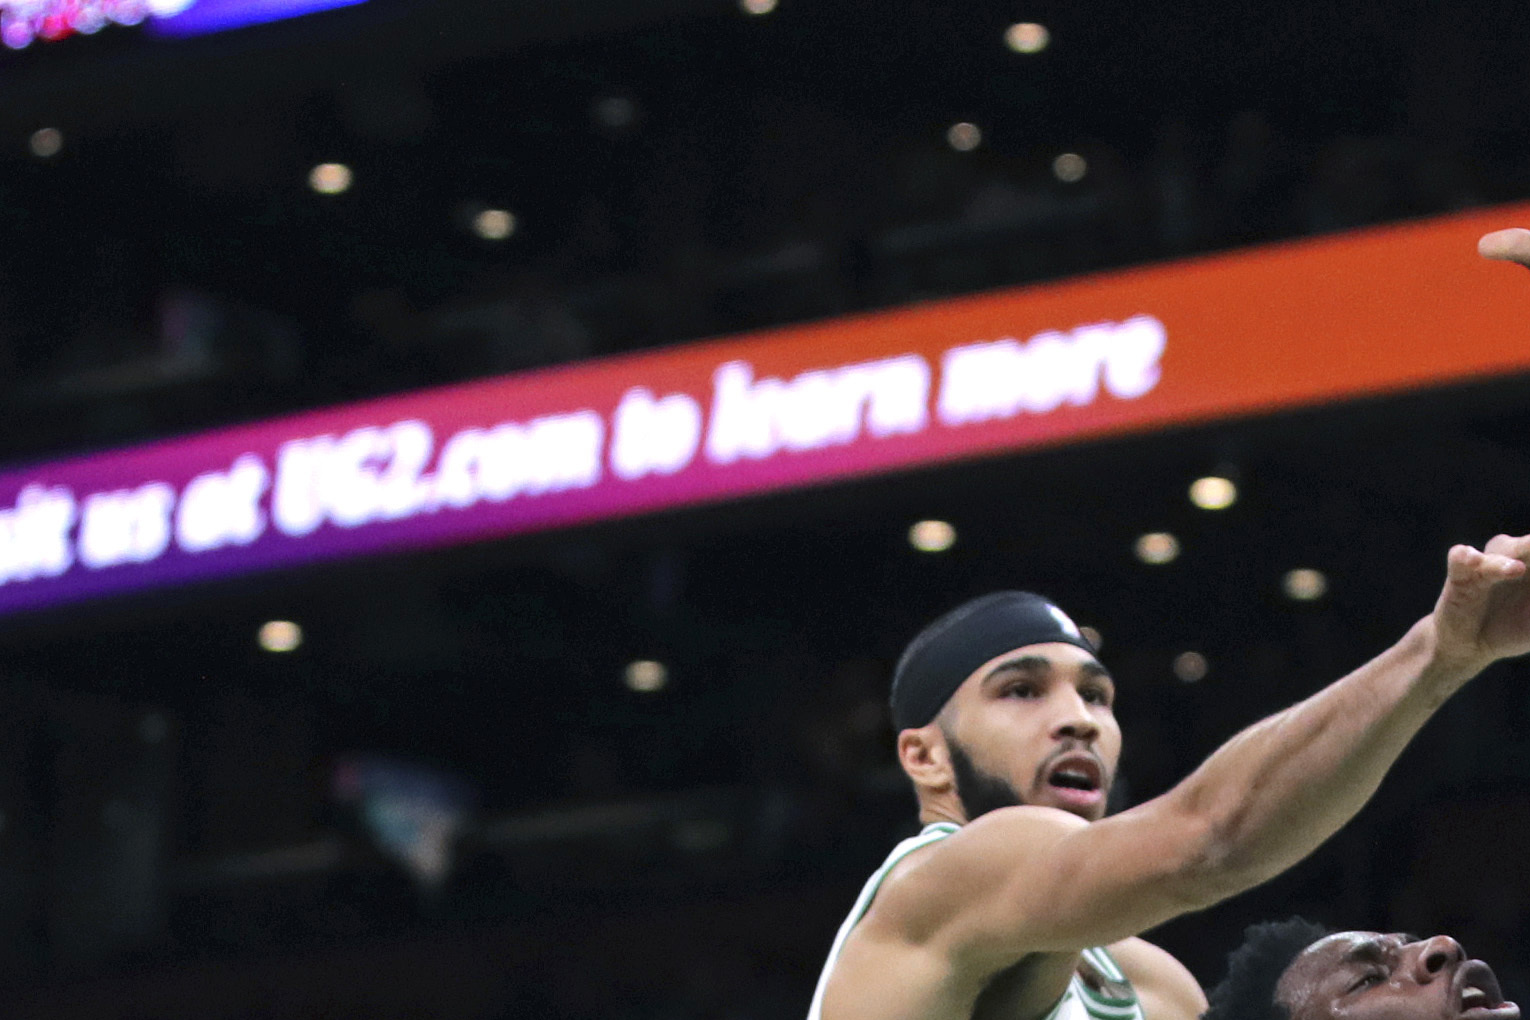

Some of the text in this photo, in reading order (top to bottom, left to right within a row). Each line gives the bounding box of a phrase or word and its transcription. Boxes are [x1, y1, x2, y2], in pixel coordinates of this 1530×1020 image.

[80, 483, 174, 567] us
[177, 453, 267, 550] at
[273, 421, 603, 534] UG2.com
[611, 387, 700, 479] to
[706, 359, 931, 463] learn
[937, 315, 1167, 424] more
